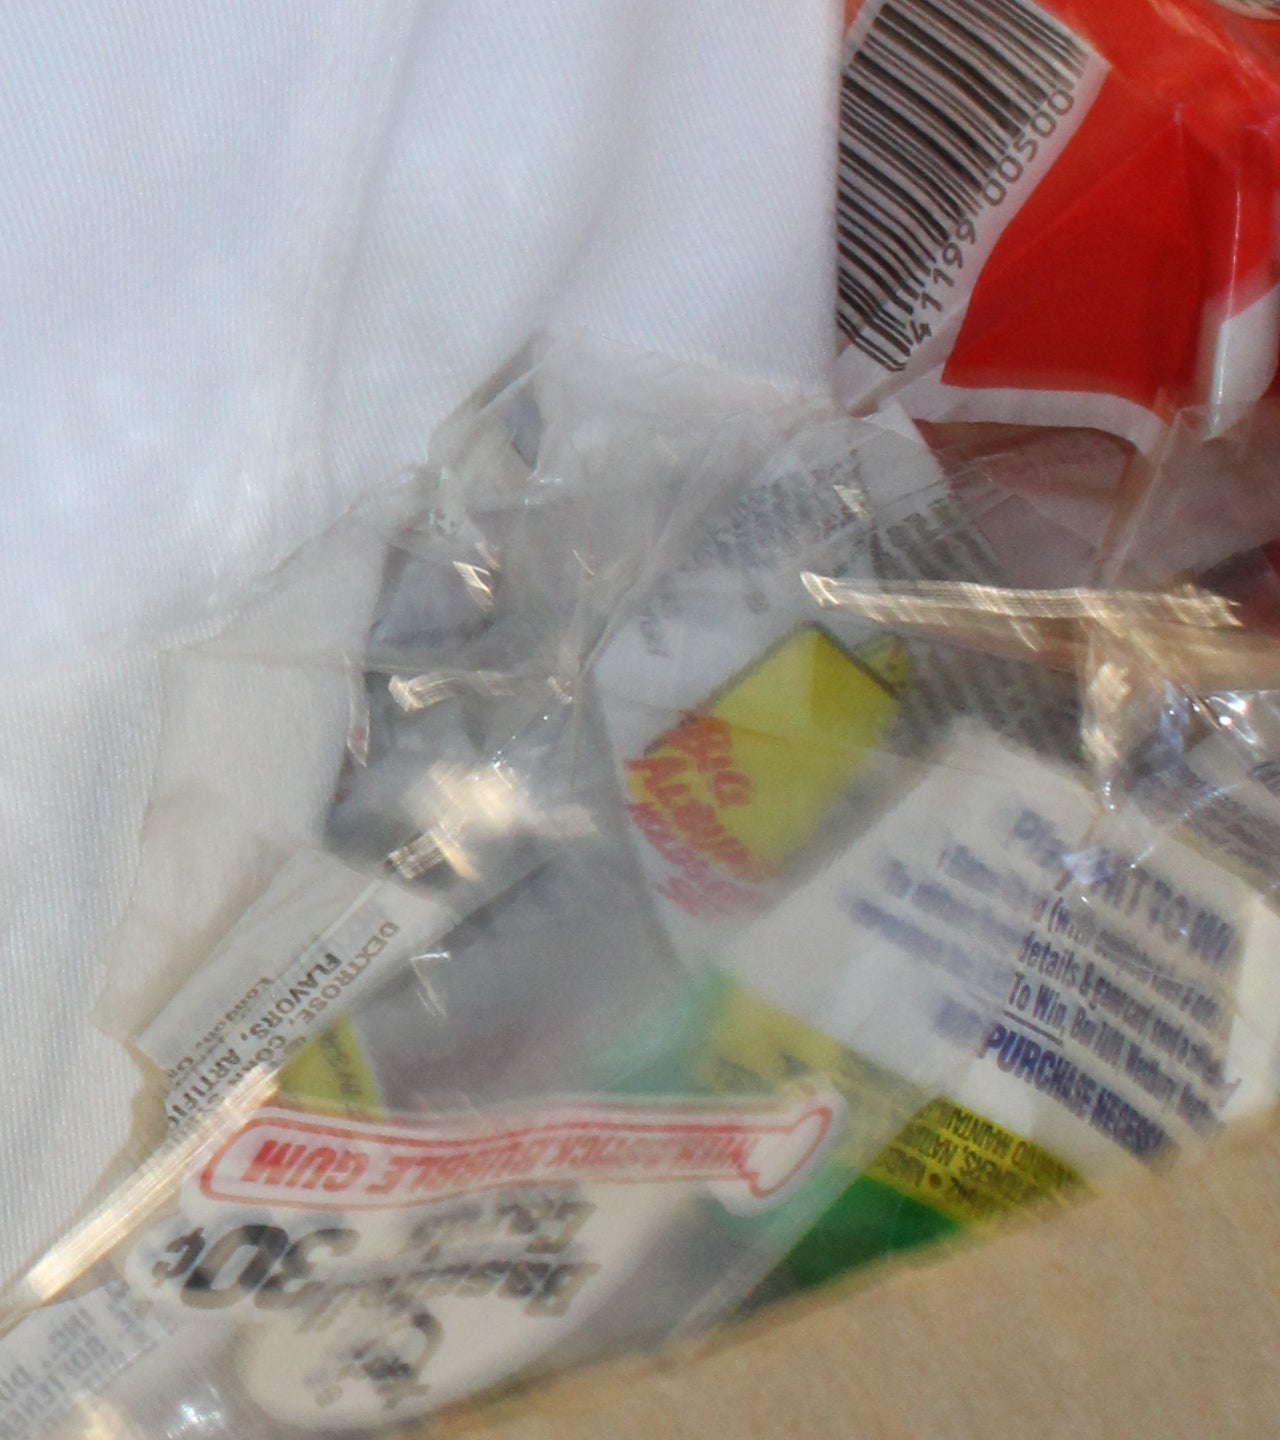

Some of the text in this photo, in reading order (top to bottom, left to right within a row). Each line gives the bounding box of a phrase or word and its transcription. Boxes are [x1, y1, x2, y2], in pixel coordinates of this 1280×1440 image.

[285, 916, 401, 1034] DEXTROSE,
[239, 1136, 367, 1194] GUM
[149, 1223, 360, 1309] 30¢
